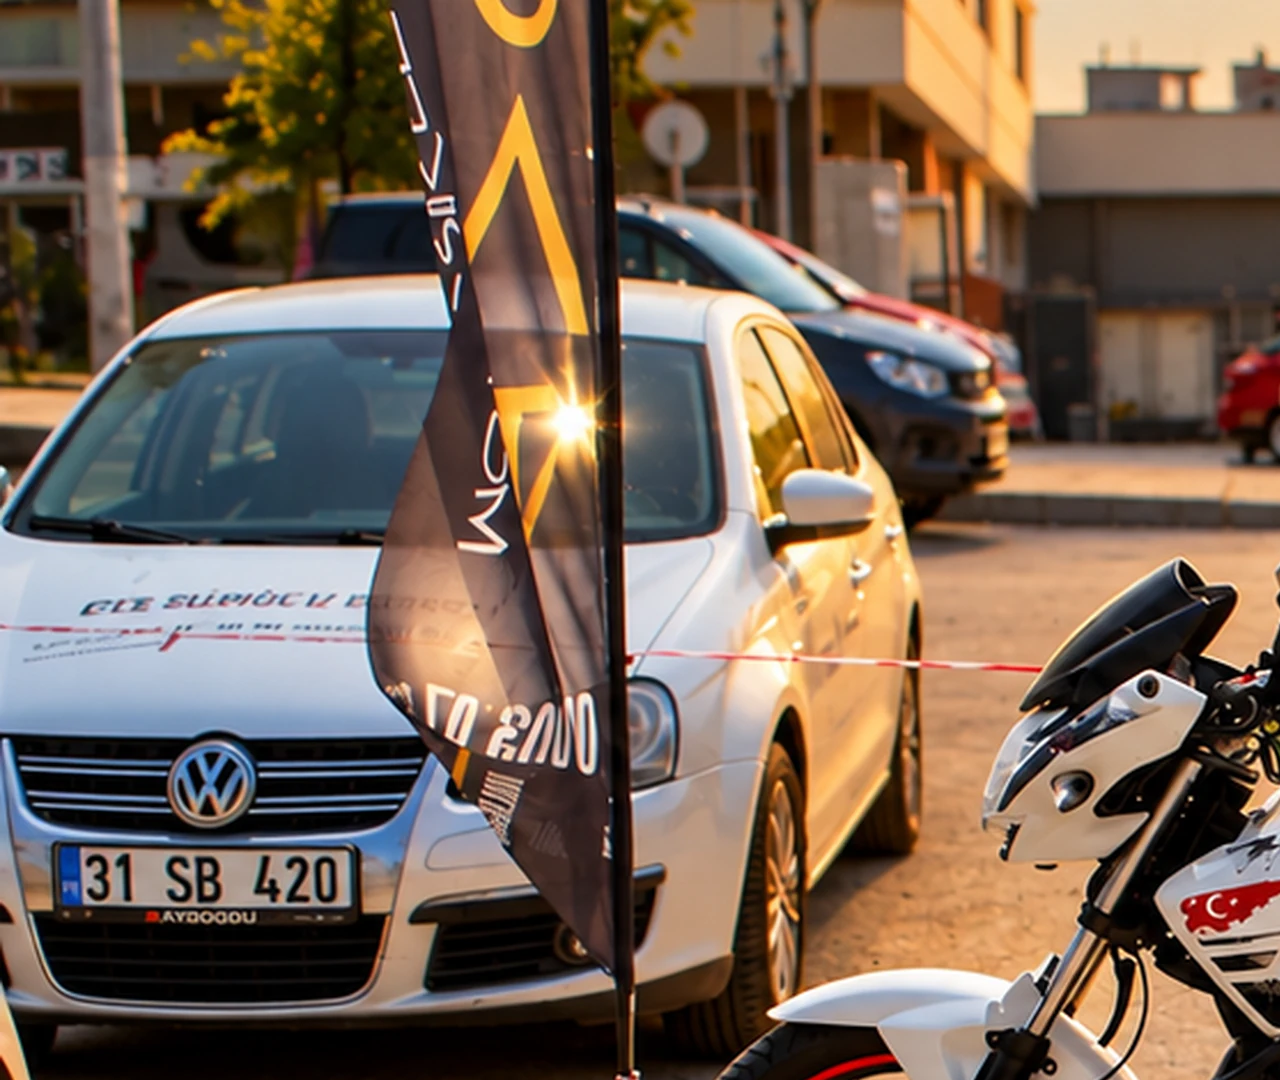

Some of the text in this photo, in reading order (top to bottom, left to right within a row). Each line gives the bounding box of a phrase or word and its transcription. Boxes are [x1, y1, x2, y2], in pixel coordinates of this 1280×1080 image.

[85, 853, 338, 904] 31 SB 420
